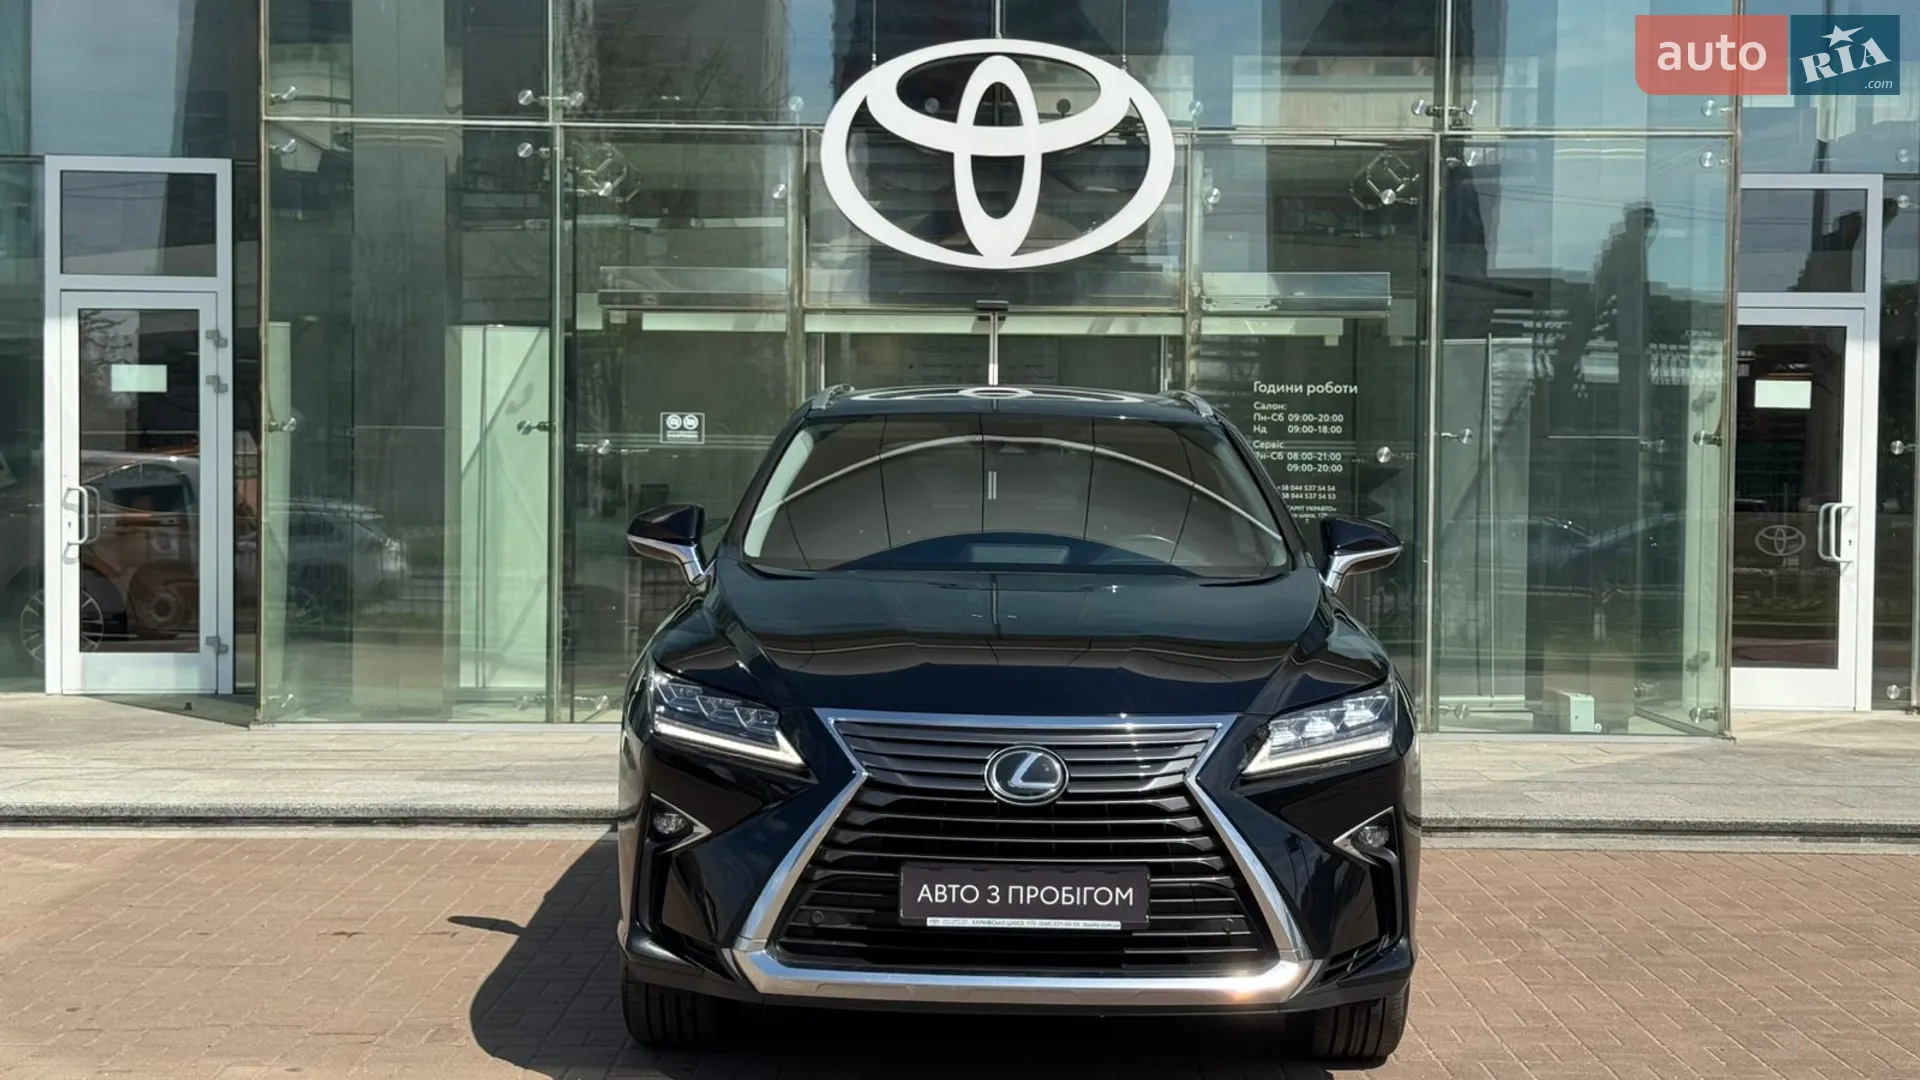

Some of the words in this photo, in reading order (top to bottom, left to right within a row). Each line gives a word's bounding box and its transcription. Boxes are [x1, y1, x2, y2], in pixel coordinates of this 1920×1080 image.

[1253, 381, 1303, 395] Години
[1306, 381, 1358, 396] роботи
[1253, 401, 1287, 411] Салон:
[1253, 412, 1285, 422] Пн-Сб
[1287, 413, 1344, 422] 09:00-20:00
[1253, 425, 1268, 434] Нд
[1287, 425, 1343, 434] 09:00-18:00
[1286, 452, 1342, 461] 08:00-21:00
[1286, 463, 1343, 472] 09:00-20:00
[917, 884, 980, 904] АВТО
[1008, 885, 1134, 906] ПРОБІГОМ
